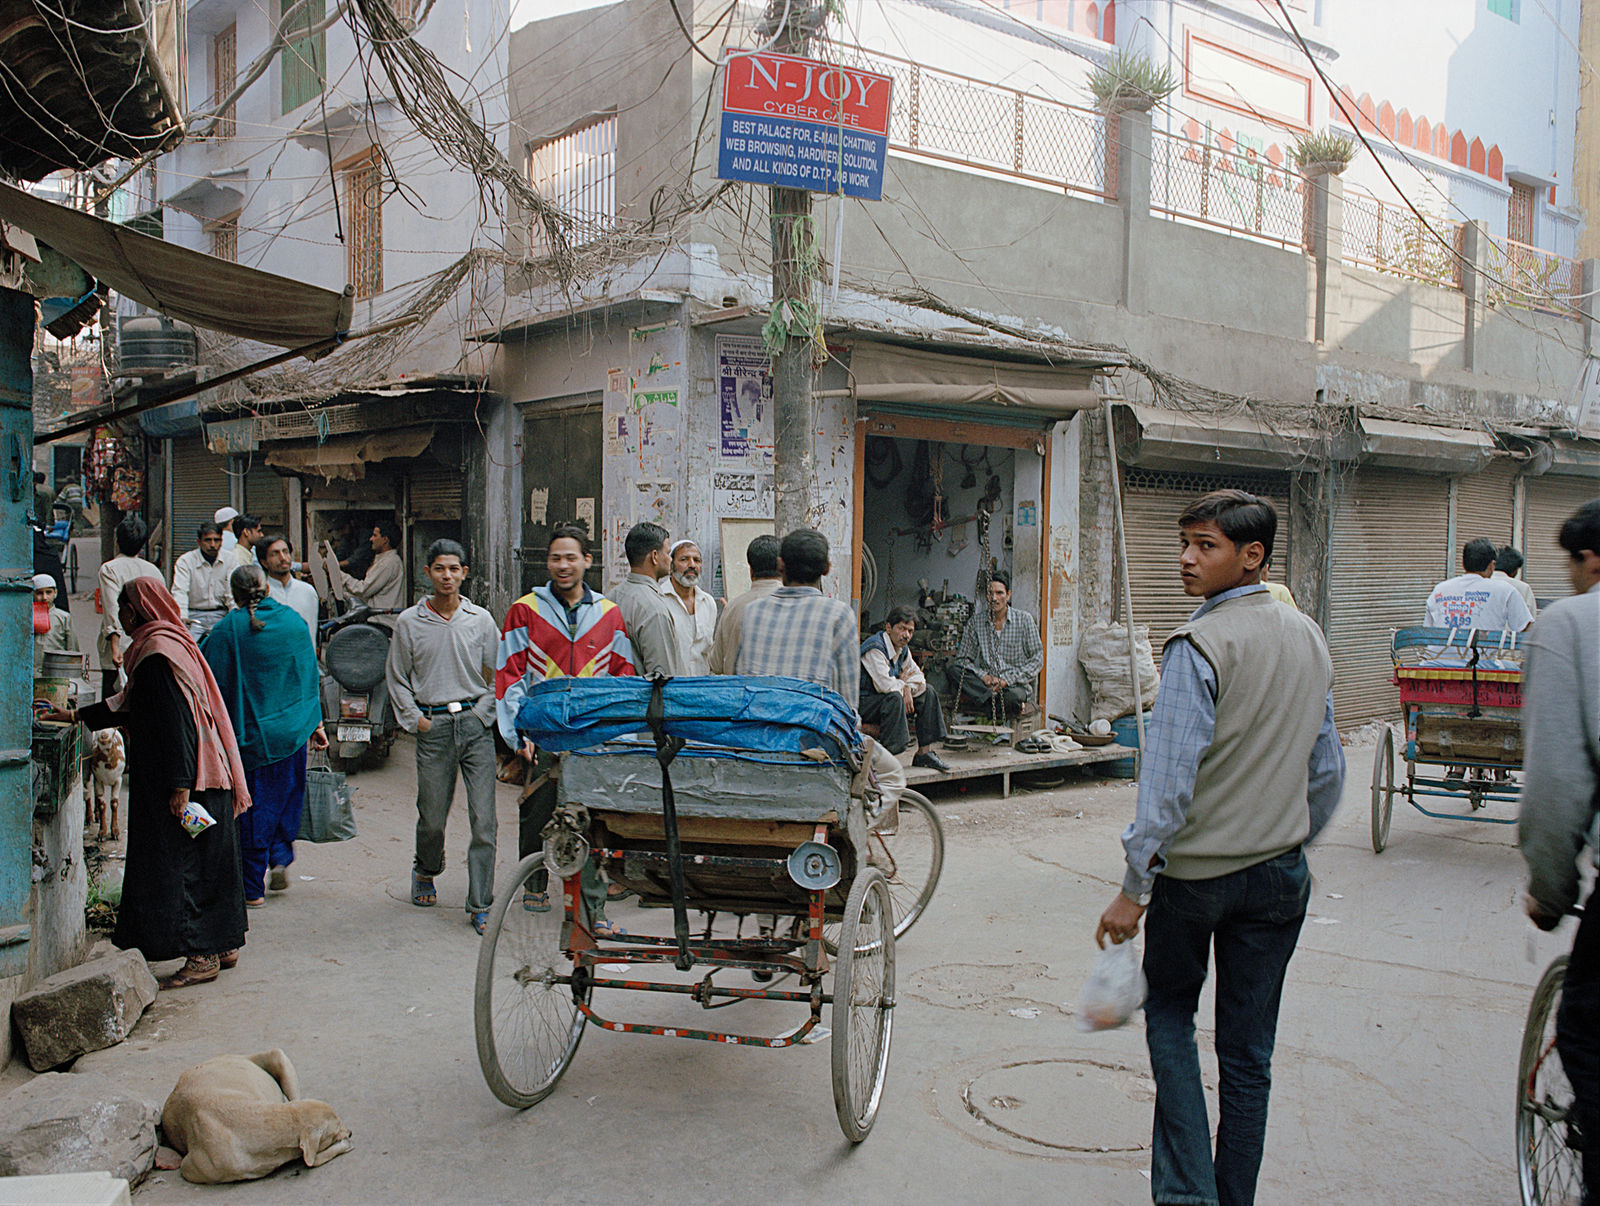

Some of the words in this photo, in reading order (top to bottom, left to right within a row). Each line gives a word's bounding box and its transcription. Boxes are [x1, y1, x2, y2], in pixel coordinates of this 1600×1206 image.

[744, 56, 878, 108] N-JOY
[763, 101, 818, 118] CYBER
[822, 110, 859, 125] CAFE
[732, 120, 756, 134] BEST
[758, 123, 792, 139] PALACE
[793, 128, 812, 144] FOR,
[843, 135, 876, 153] CHATTING
[726, 137, 746, 151] WEB
[748, 140, 796, 160] BROWSING,
[843, 153, 878, 174] SOLUTION,
[732, 157, 752, 171] AND
[753, 160, 770, 173] ALL
[772, 161, 798, 176] KINDS
[800, 164, 812, 178] OF
[849, 172, 870, 188] WORK
[1408, 680, 1447, 693] ALTAF
